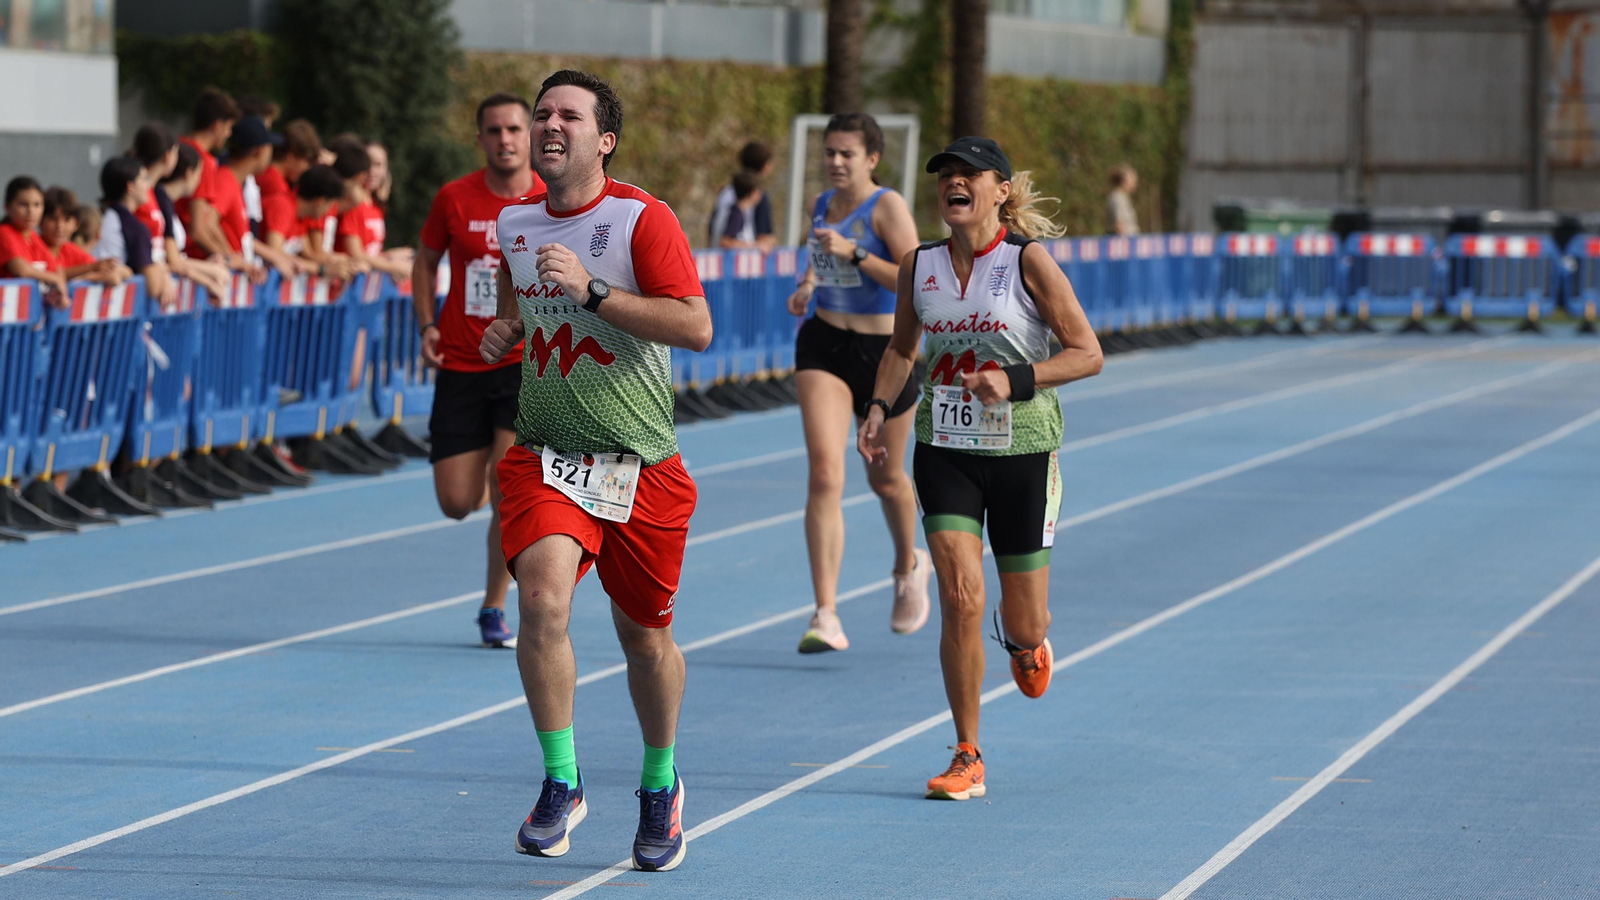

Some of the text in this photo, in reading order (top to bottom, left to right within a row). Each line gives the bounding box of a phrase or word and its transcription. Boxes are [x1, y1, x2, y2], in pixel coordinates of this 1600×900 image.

[513, 283, 565, 299] mara
[534, 304, 579, 315] JEREZ
[923, 311, 1009, 334] maratón
[939, 403, 973, 427] 716
[550, 457, 592, 489] 521
